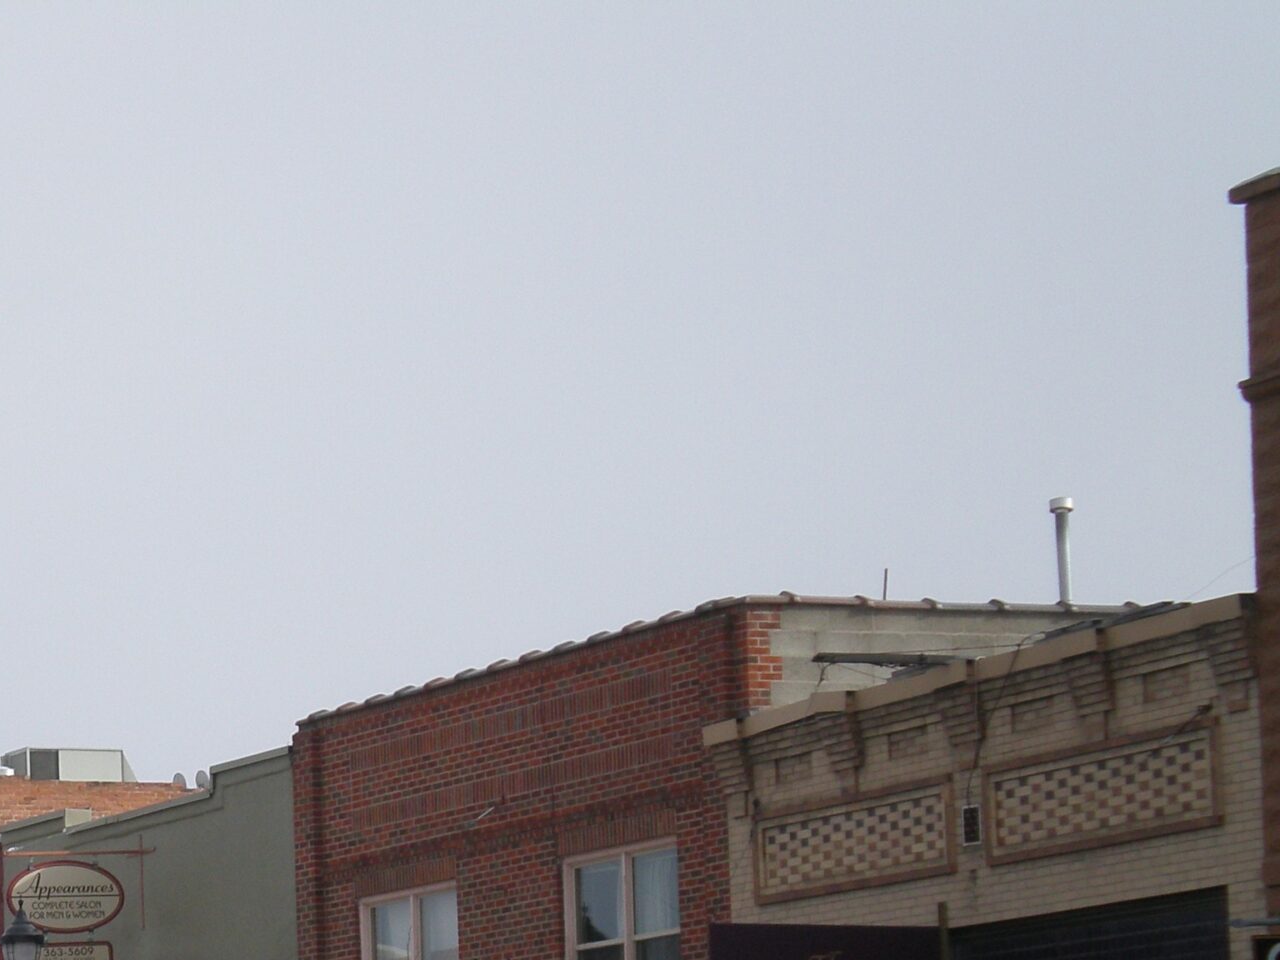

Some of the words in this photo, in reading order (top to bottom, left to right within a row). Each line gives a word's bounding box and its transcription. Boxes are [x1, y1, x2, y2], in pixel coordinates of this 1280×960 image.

[17, 872, 114, 900] Appearances
[32, 901, 74, 910] COMPLETE
[76, 901, 102, 909] SALON
[29, 912, 45, 920] FOR
[46, 911, 65, 919] MEN
[73, 911, 105, 919] WOMEN
[44, 947, 94, 957] 363-5609
